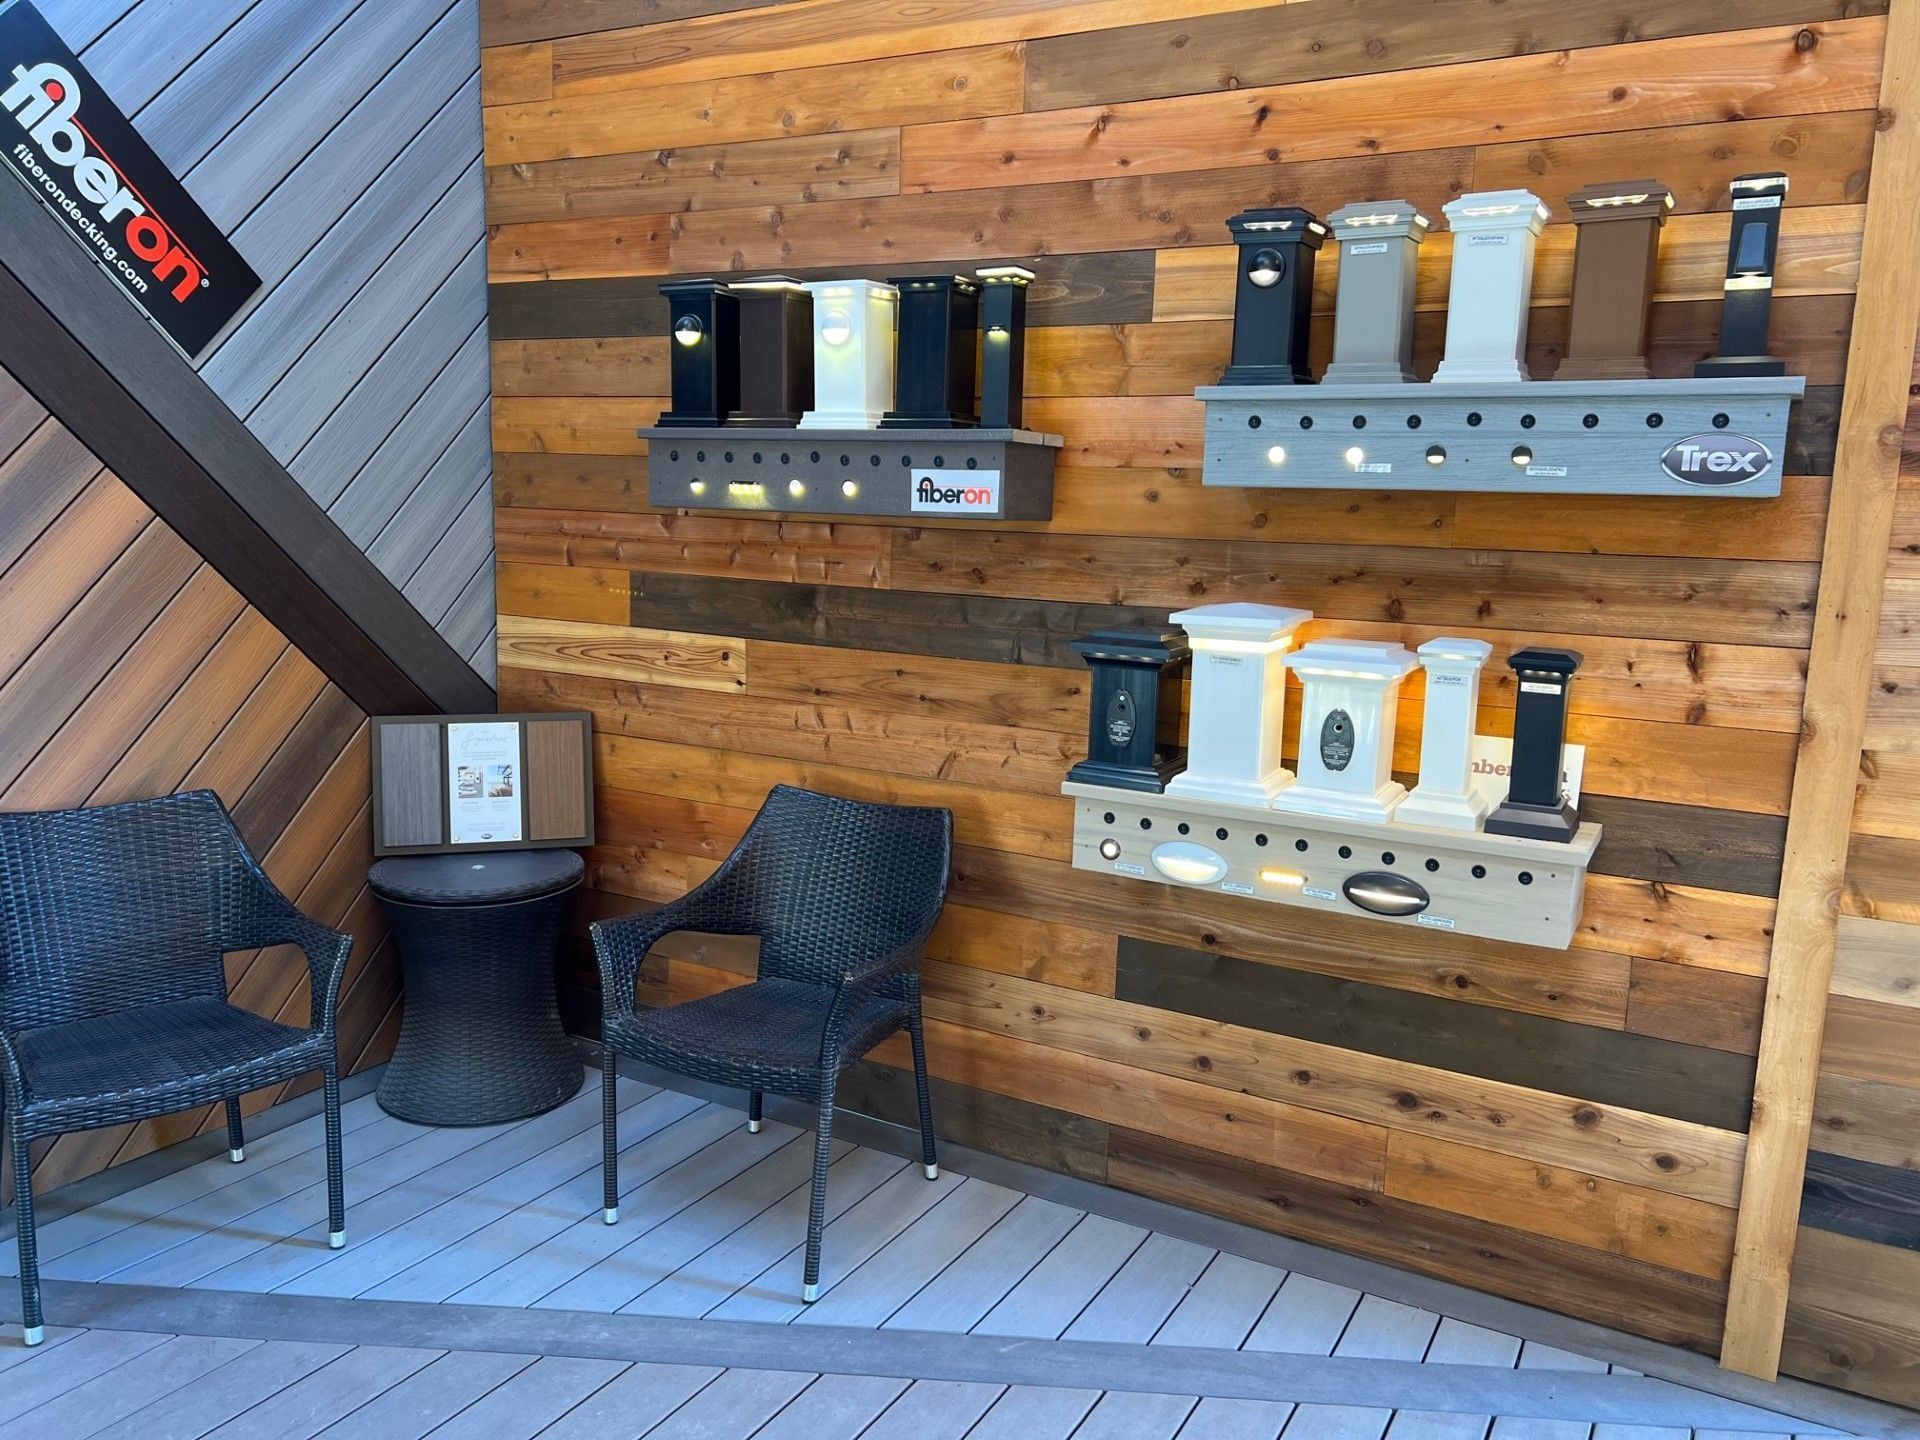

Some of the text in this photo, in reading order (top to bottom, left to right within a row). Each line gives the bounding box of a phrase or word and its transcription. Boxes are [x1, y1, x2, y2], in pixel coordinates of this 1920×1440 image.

[0, 62, 201, 304] fiberon
[13, 143, 149, 294] fiberondecking.com
[916, 476, 991, 504] fiberon
[1676, 445, 1761, 472] Trex
